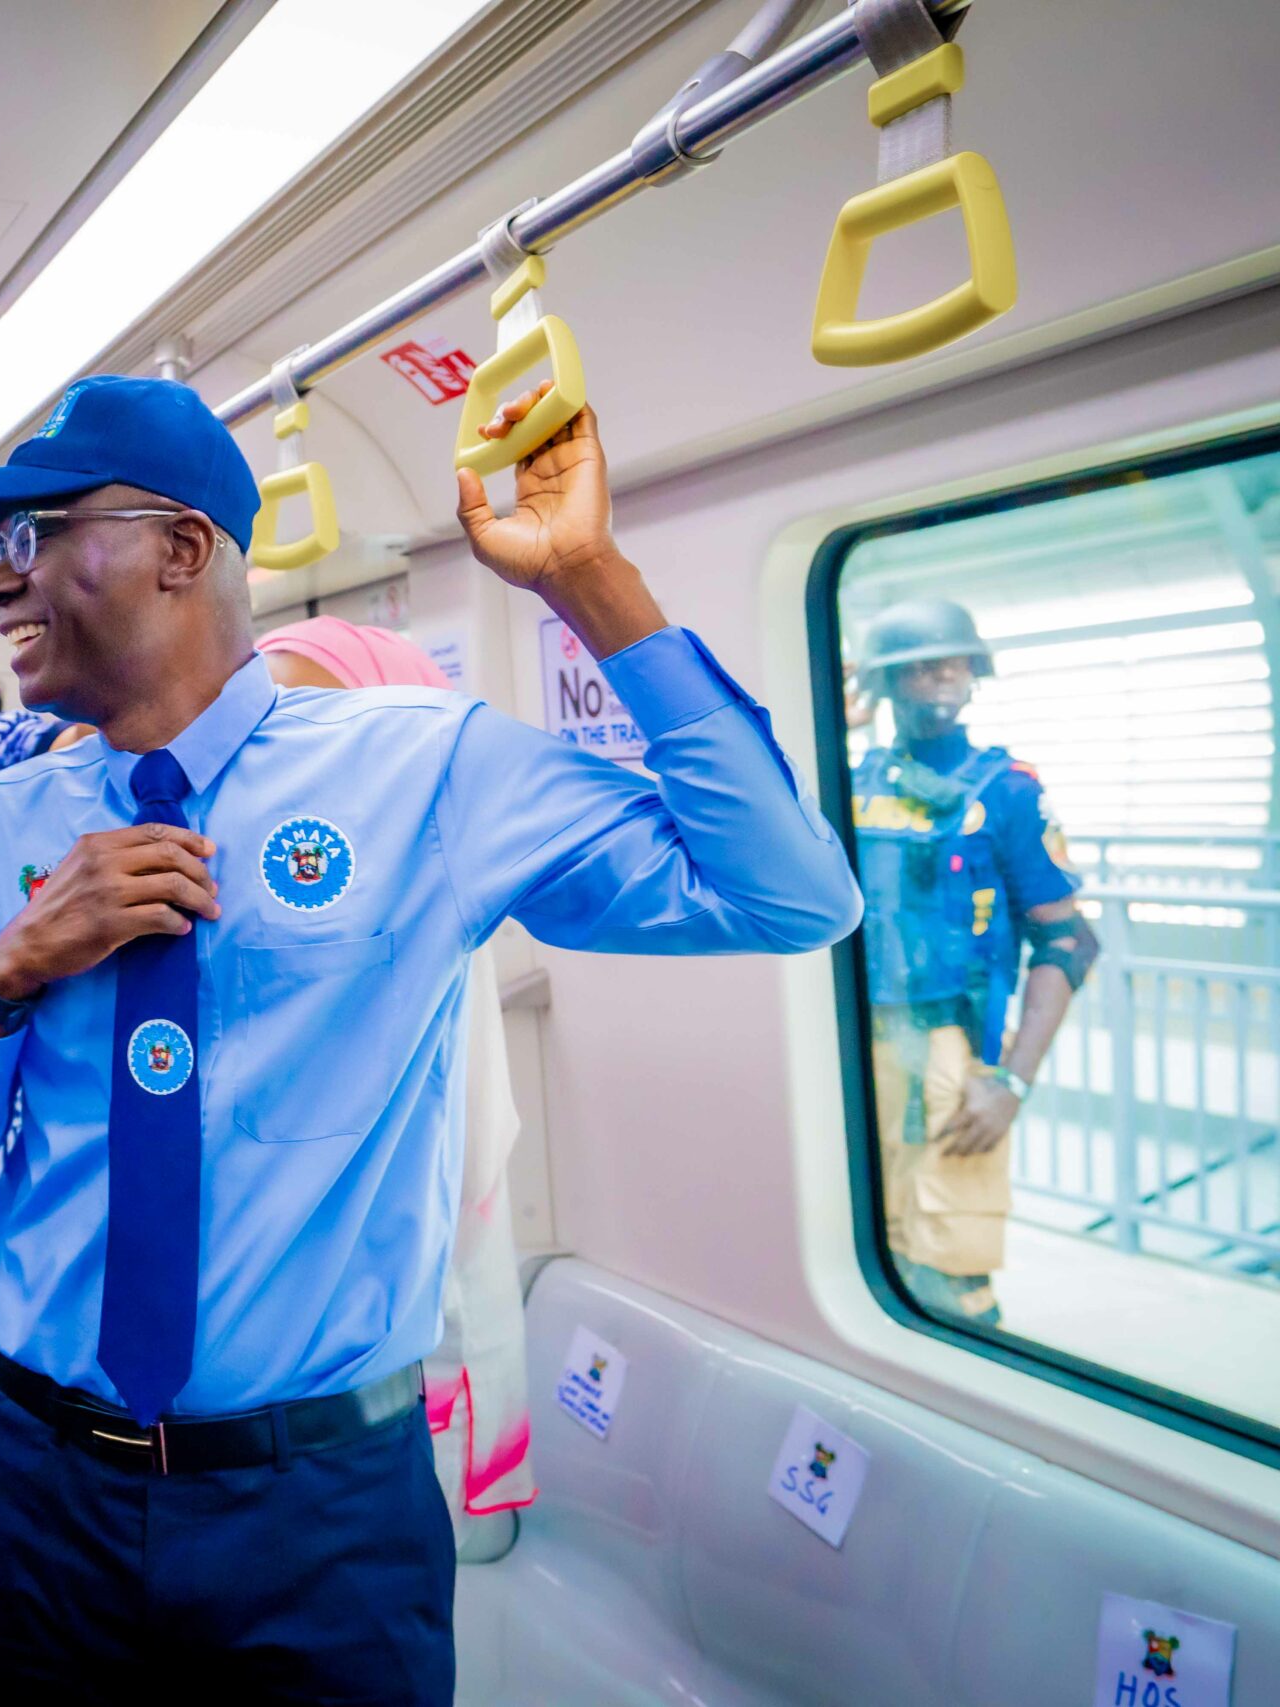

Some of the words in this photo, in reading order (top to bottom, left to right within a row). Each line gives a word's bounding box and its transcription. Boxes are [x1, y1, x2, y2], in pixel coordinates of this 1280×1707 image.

[581, 724, 607, 745] THE
[610, 723, 643, 744] TRA
[271, 828, 342, 862] LAMATA
